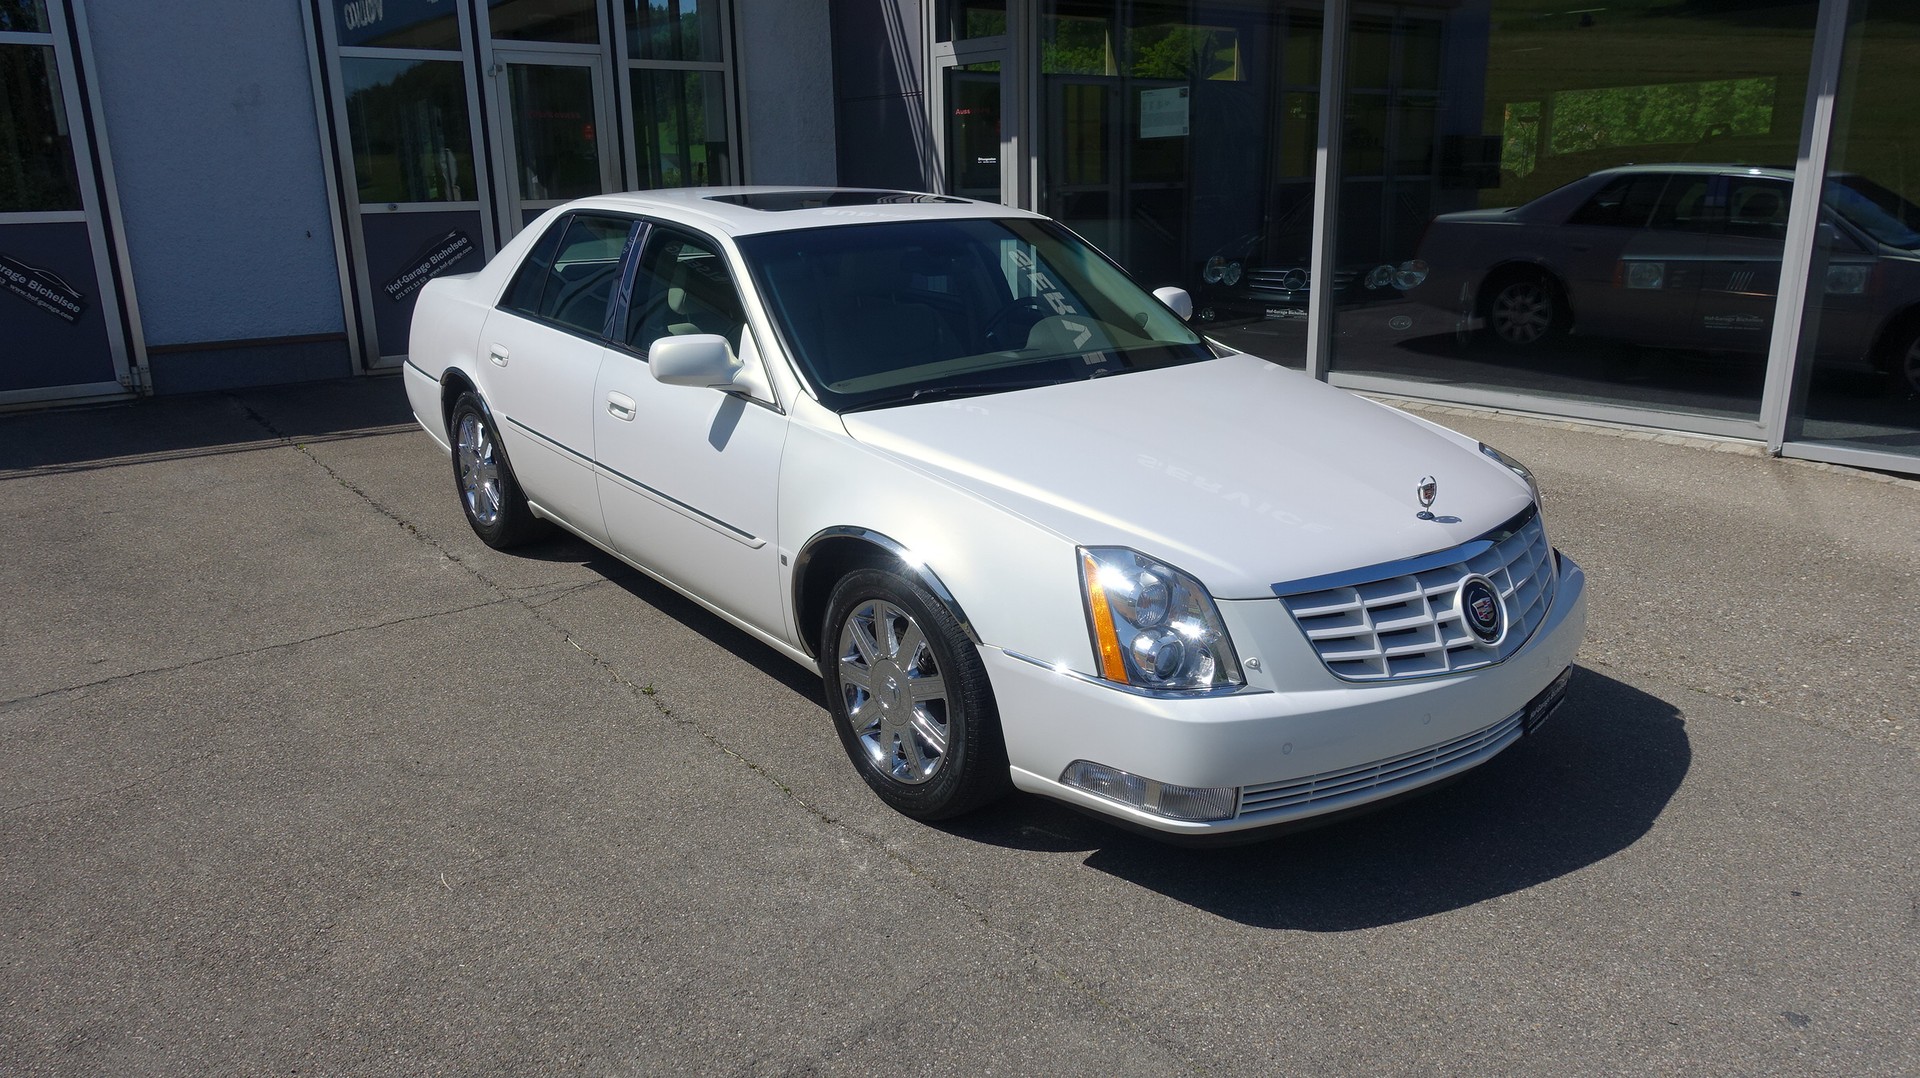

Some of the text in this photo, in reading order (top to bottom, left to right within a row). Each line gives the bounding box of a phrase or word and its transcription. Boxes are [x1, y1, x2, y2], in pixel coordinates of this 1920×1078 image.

[386, 237, 468, 294] Hof-Garage Bichelsee
[10, 283, 74, 321] www.hof-garage.com
[27, 279, 81, 313] Bichelsee
